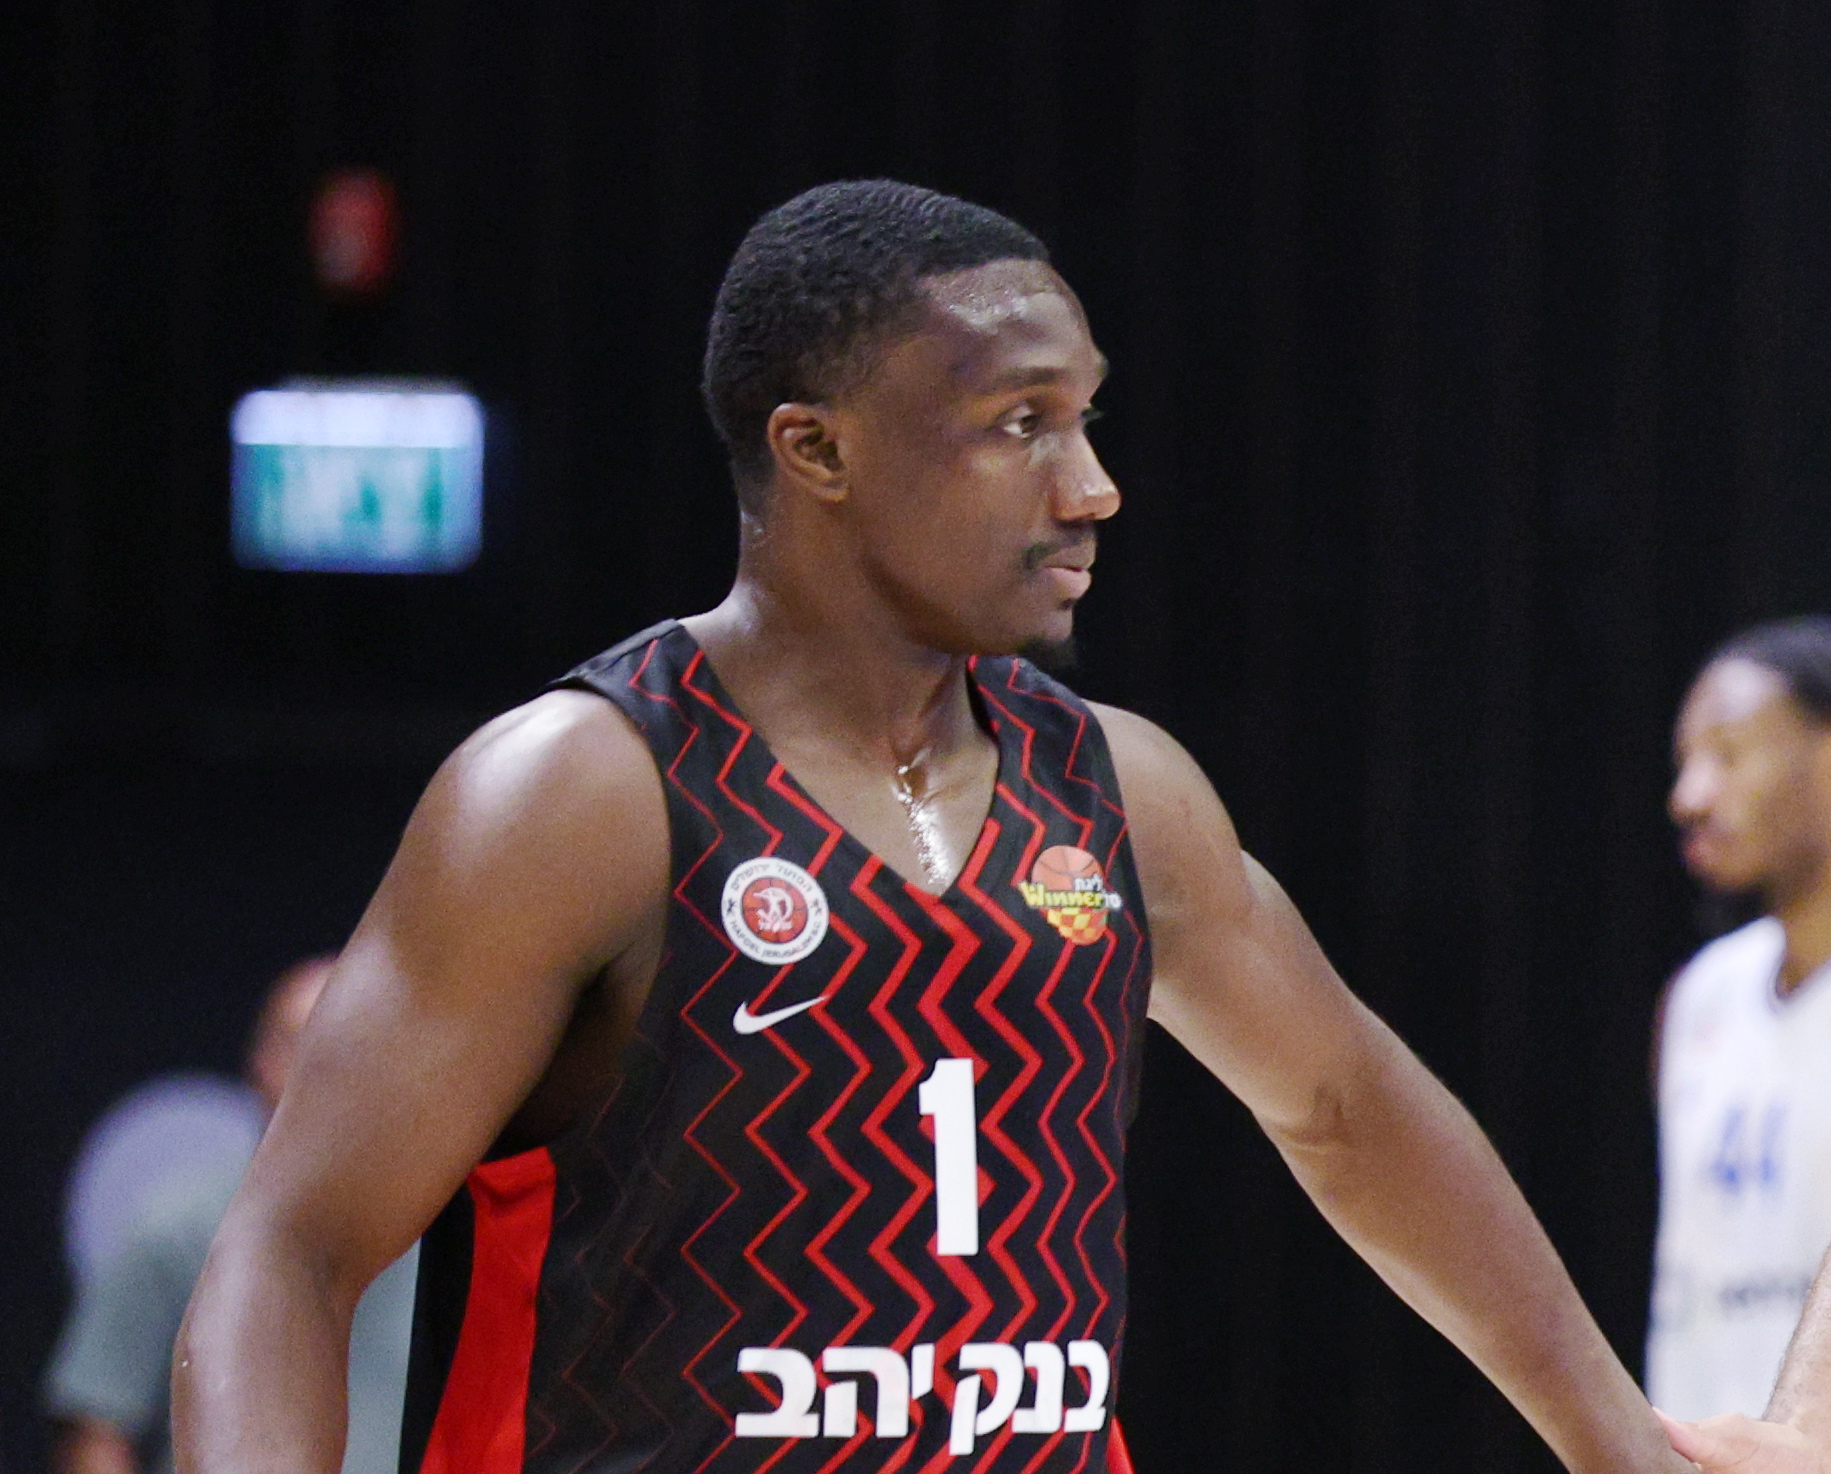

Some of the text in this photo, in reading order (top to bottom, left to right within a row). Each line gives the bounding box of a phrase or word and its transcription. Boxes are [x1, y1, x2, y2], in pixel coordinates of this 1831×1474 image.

[1019, 880, 1105, 907] Winner
[918, 1058, 979, 1255] 1
[735, 1340, 1110, 1456] בנק יהב
